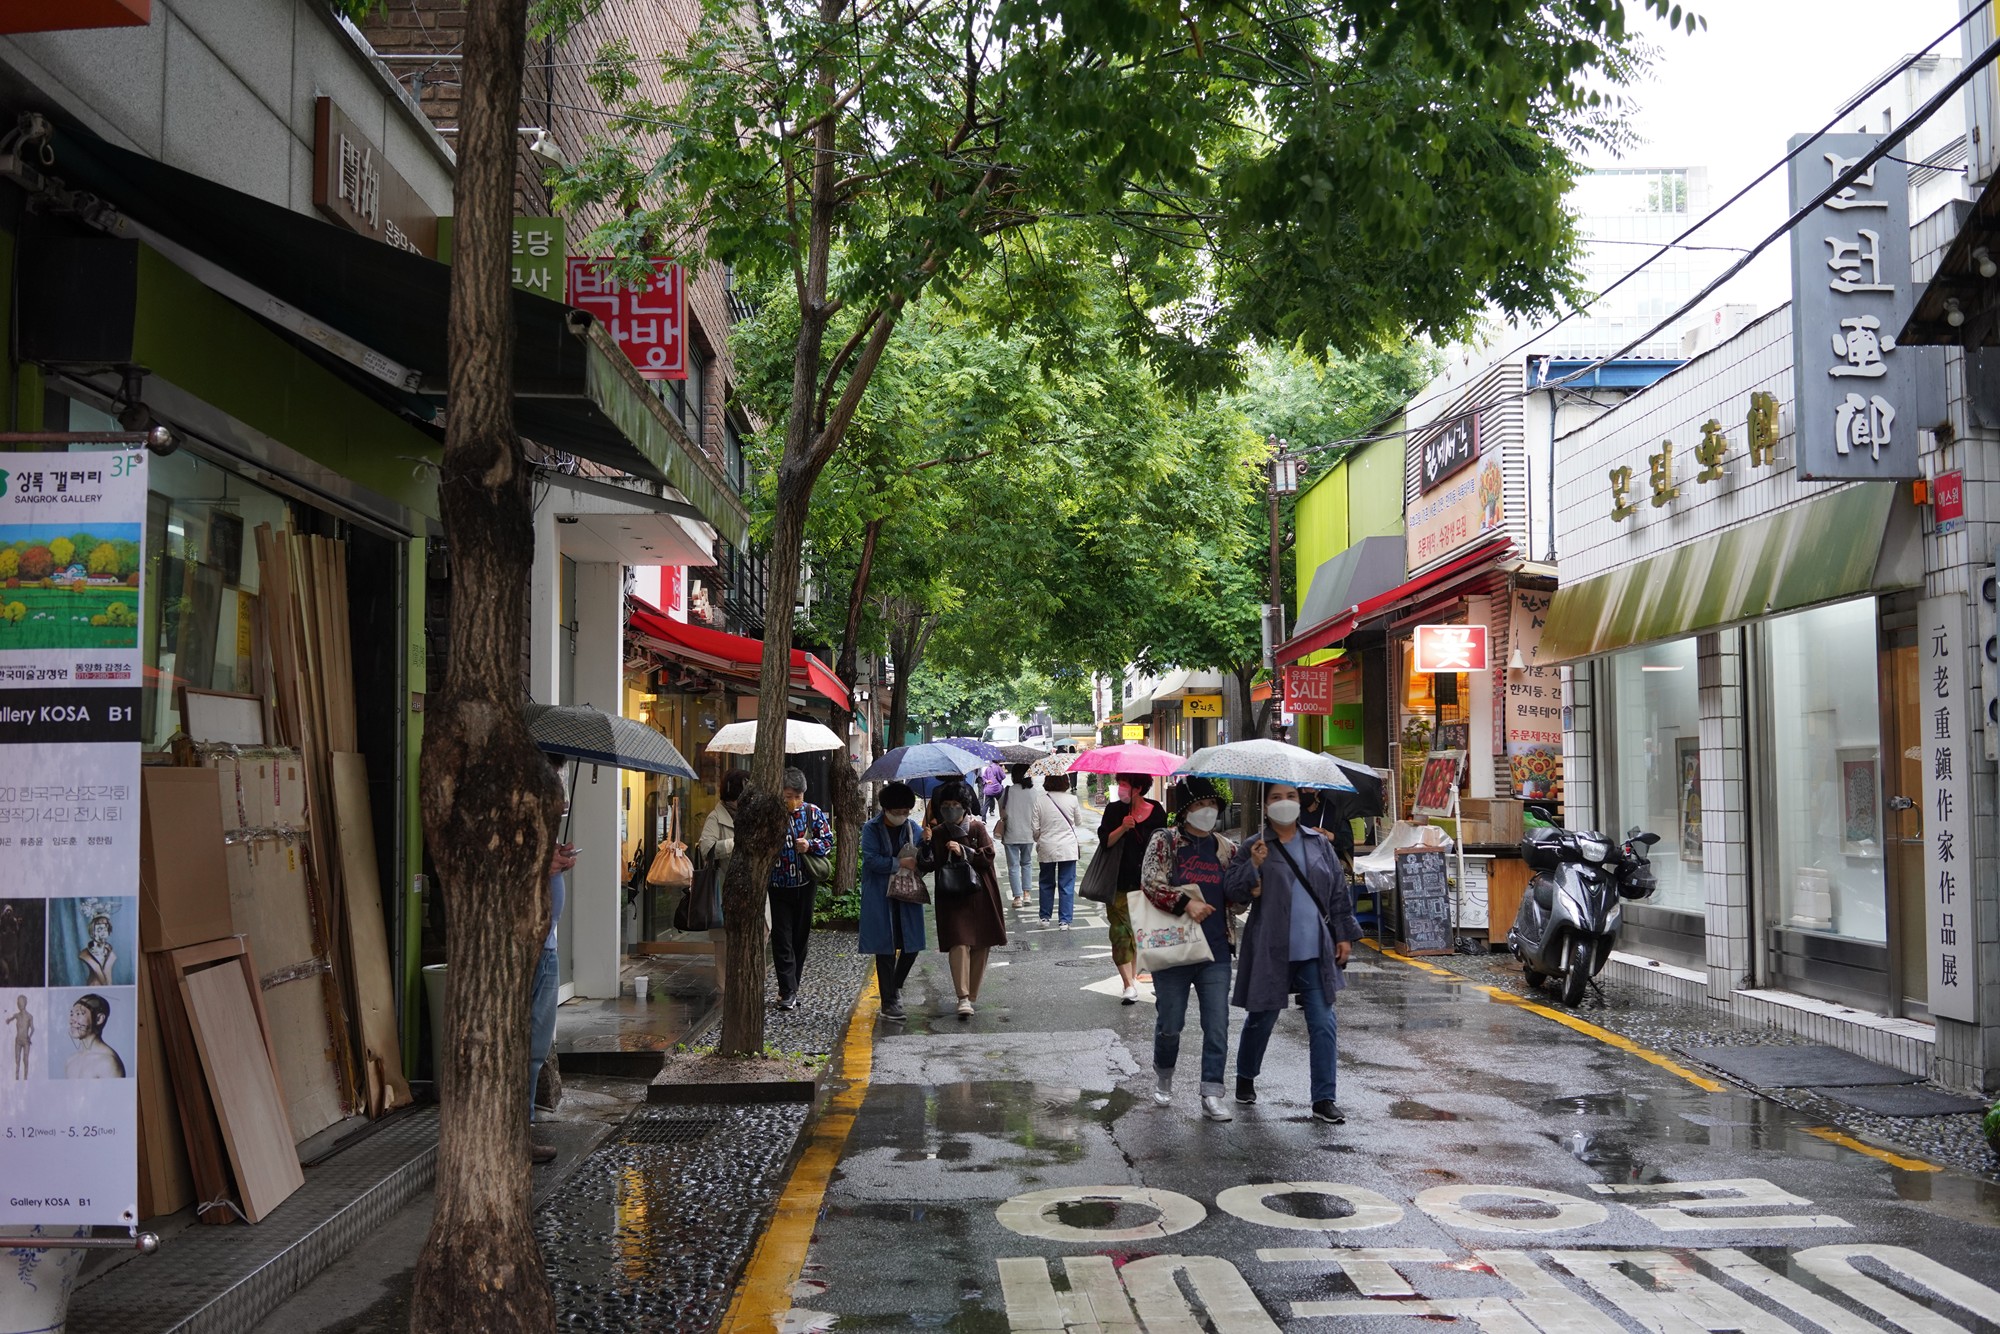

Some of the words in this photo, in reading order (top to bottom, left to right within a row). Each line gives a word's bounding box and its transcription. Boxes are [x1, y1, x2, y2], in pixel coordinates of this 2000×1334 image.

[110, 455, 138, 477] 3F
[16, 472, 43, 493] 상록
[50, 471, 102, 492] 갤러리
[15, 494, 58, 504] SANGROK
[61, 493, 103, 503] GALLERY
[1937, 487, 1959, 507] 에스원
[1428, 628, 1476, 668] 꽃
[75, 663, 102, 672] 동양화
[104, 663, 132, 672] 감정소
[1291, 671, 1328, 682] 유화그림
[1291, 681, 1327, 699] SALE
[0, 706, 36, 725] llery
[41, 706, 90, 722] KOSA
[108, 706, 132, 722] B1
[74, 806, 122, 822] 전시회
[10, 1197, 42, 1208] Gallery
[44, 1197, 70, 1207] KOSA
[79, 1198, 91, 1206] B1
